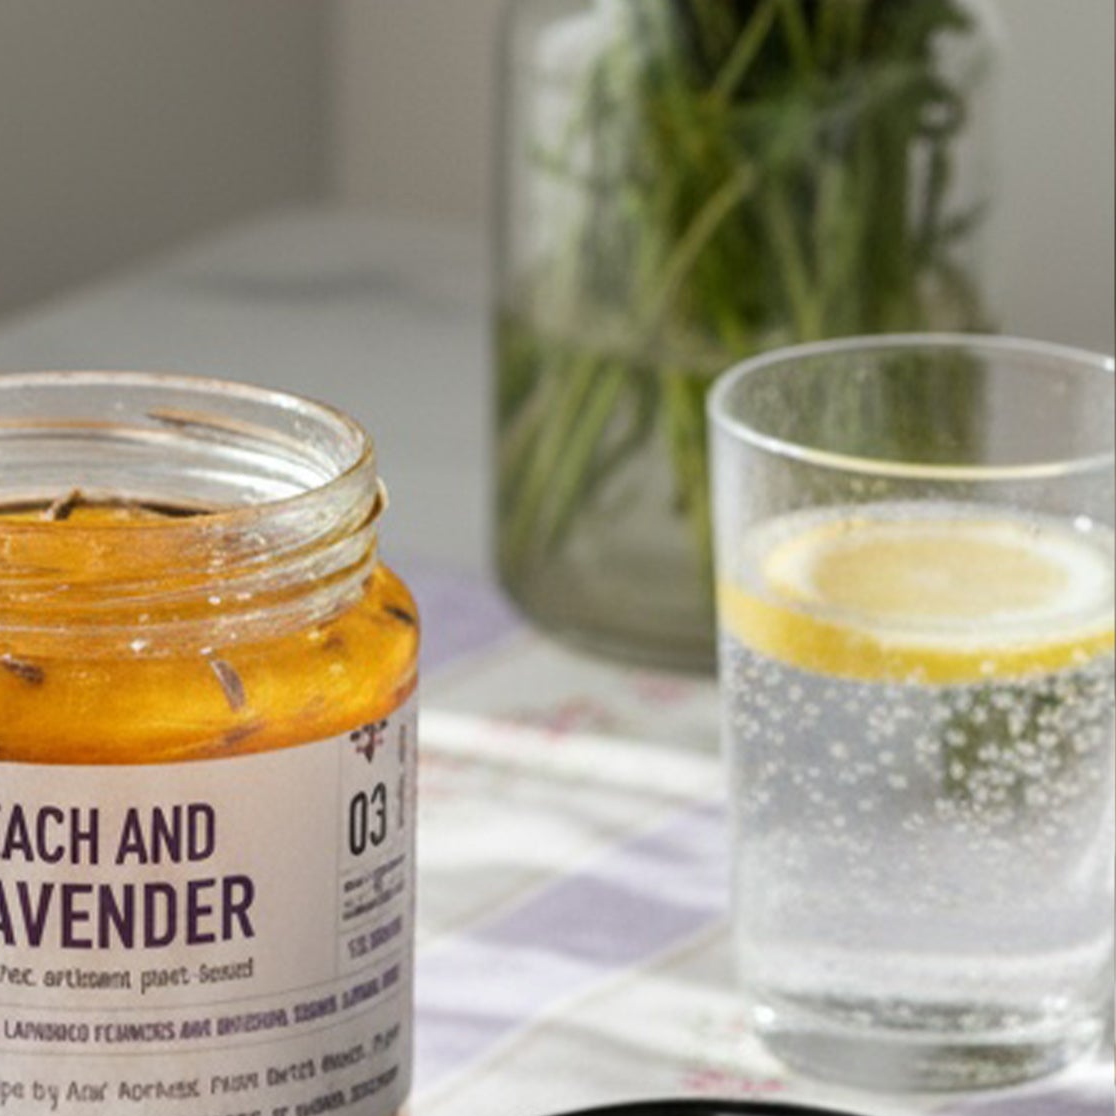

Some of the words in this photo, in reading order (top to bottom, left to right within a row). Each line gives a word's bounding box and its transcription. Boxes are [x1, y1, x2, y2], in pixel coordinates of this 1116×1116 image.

[115, 803, 216, 865] AND
[349, 781, 387, 856] 03
[33, 1080, 60, 1111] by
